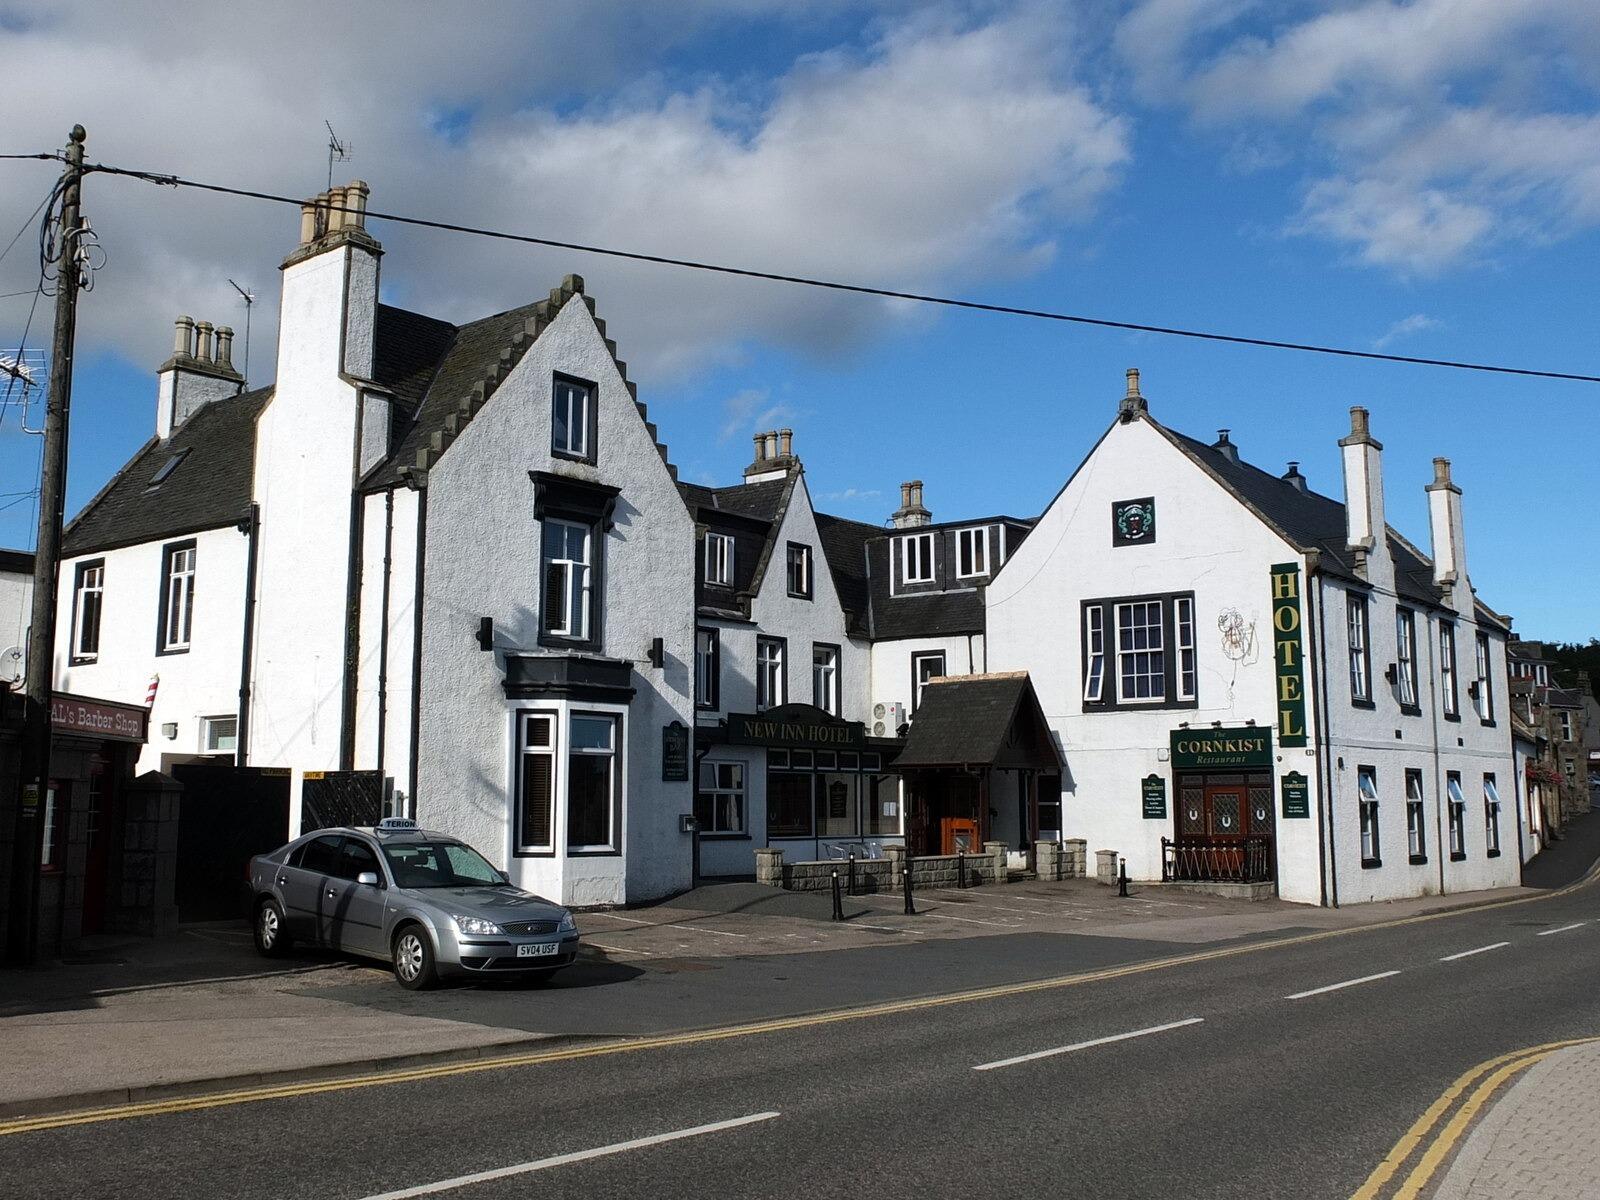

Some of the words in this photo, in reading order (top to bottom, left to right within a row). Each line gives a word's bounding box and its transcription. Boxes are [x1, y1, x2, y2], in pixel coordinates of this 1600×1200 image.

[1272, 572, 1303, 737] HOTEL
[78, 707, 113, 729] Barber
[115, 713, 138, 737] Shop
[744, 721, 778, 738] NEW
[781, 724, 805, 741] INN
[809, 726, 854, 743] HOTEL
[1177, 738, 1264, 754] CORNKIST
[1196, 755, 1246, 765] Restaurant
[520, 945, 541, 956] SV04
[542, 943, 556, 954] USF
